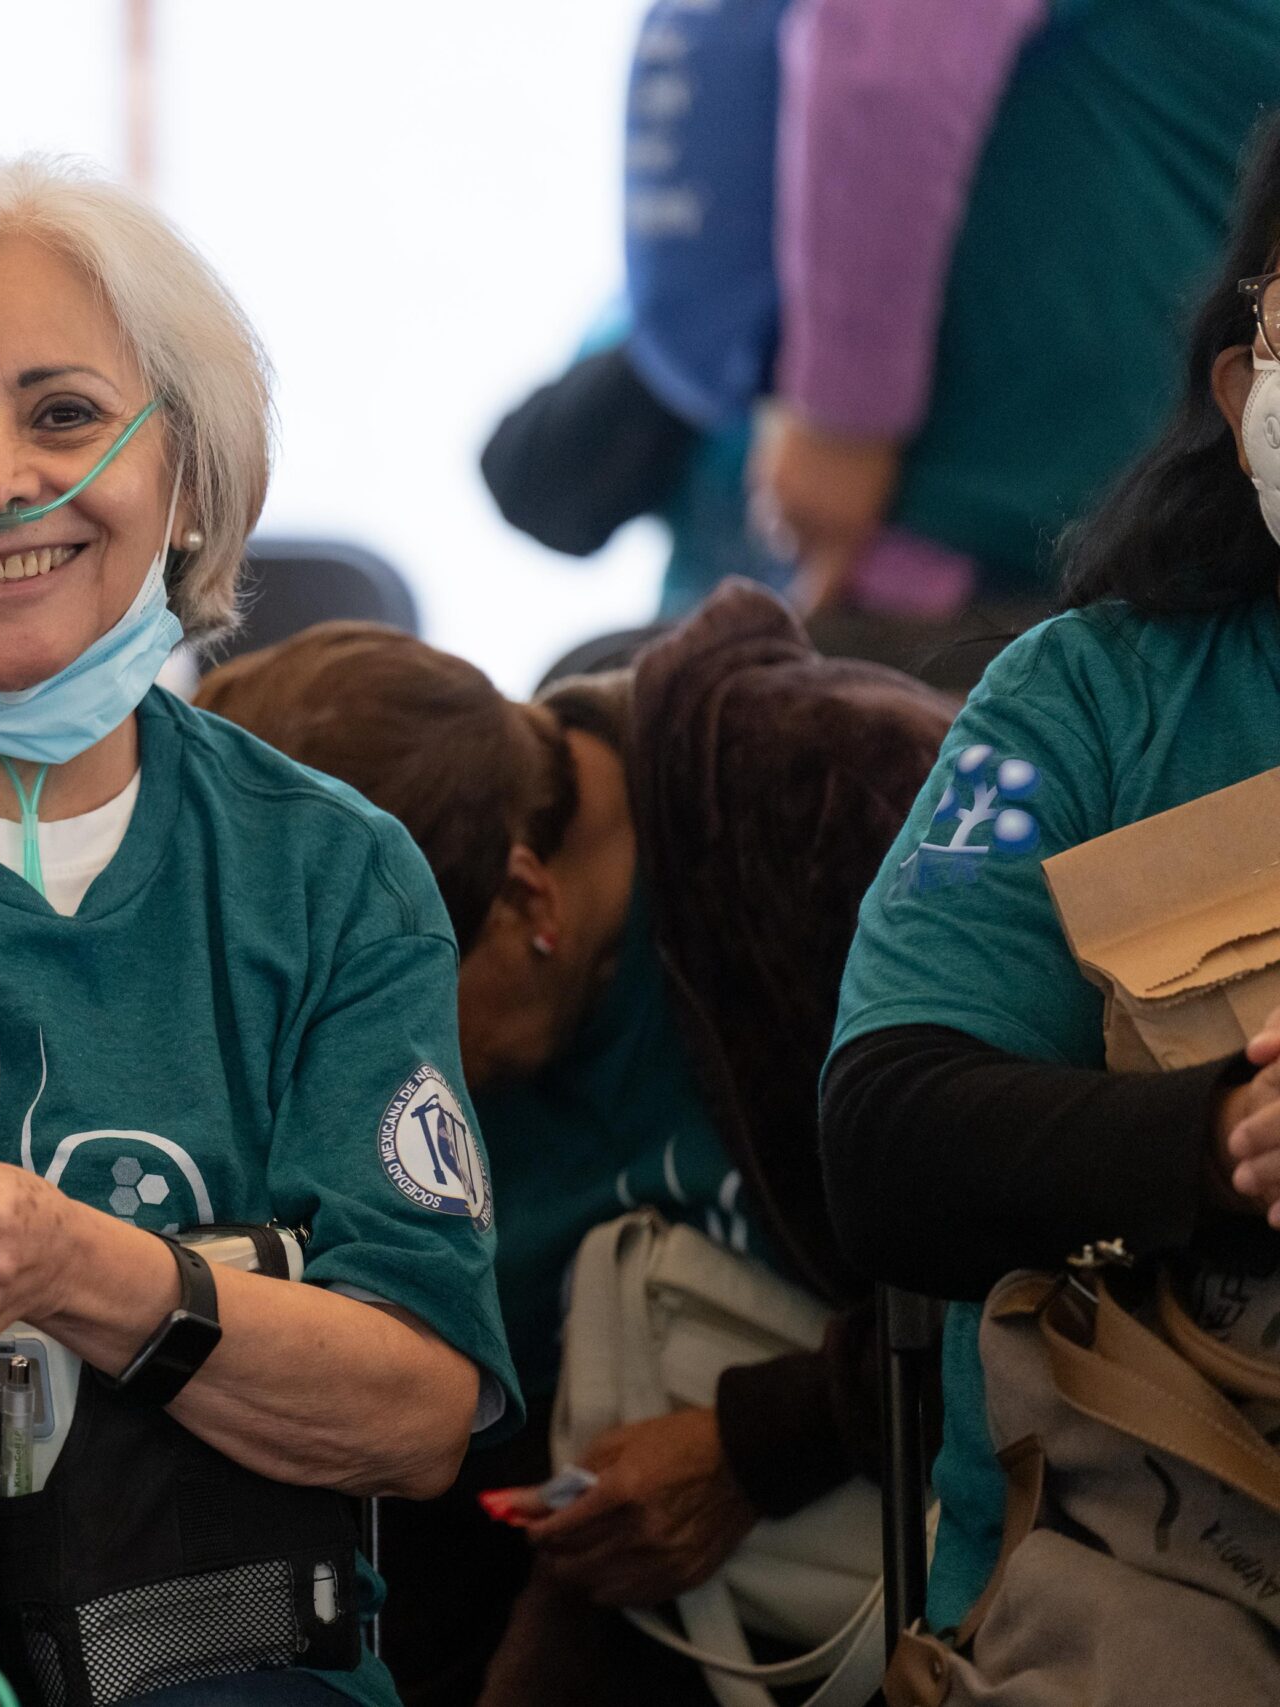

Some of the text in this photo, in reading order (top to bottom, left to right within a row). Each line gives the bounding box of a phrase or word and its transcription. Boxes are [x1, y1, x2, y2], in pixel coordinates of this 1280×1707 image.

[381, 1082, 442, 1208] SOCIEDAD MEXICANA DE
